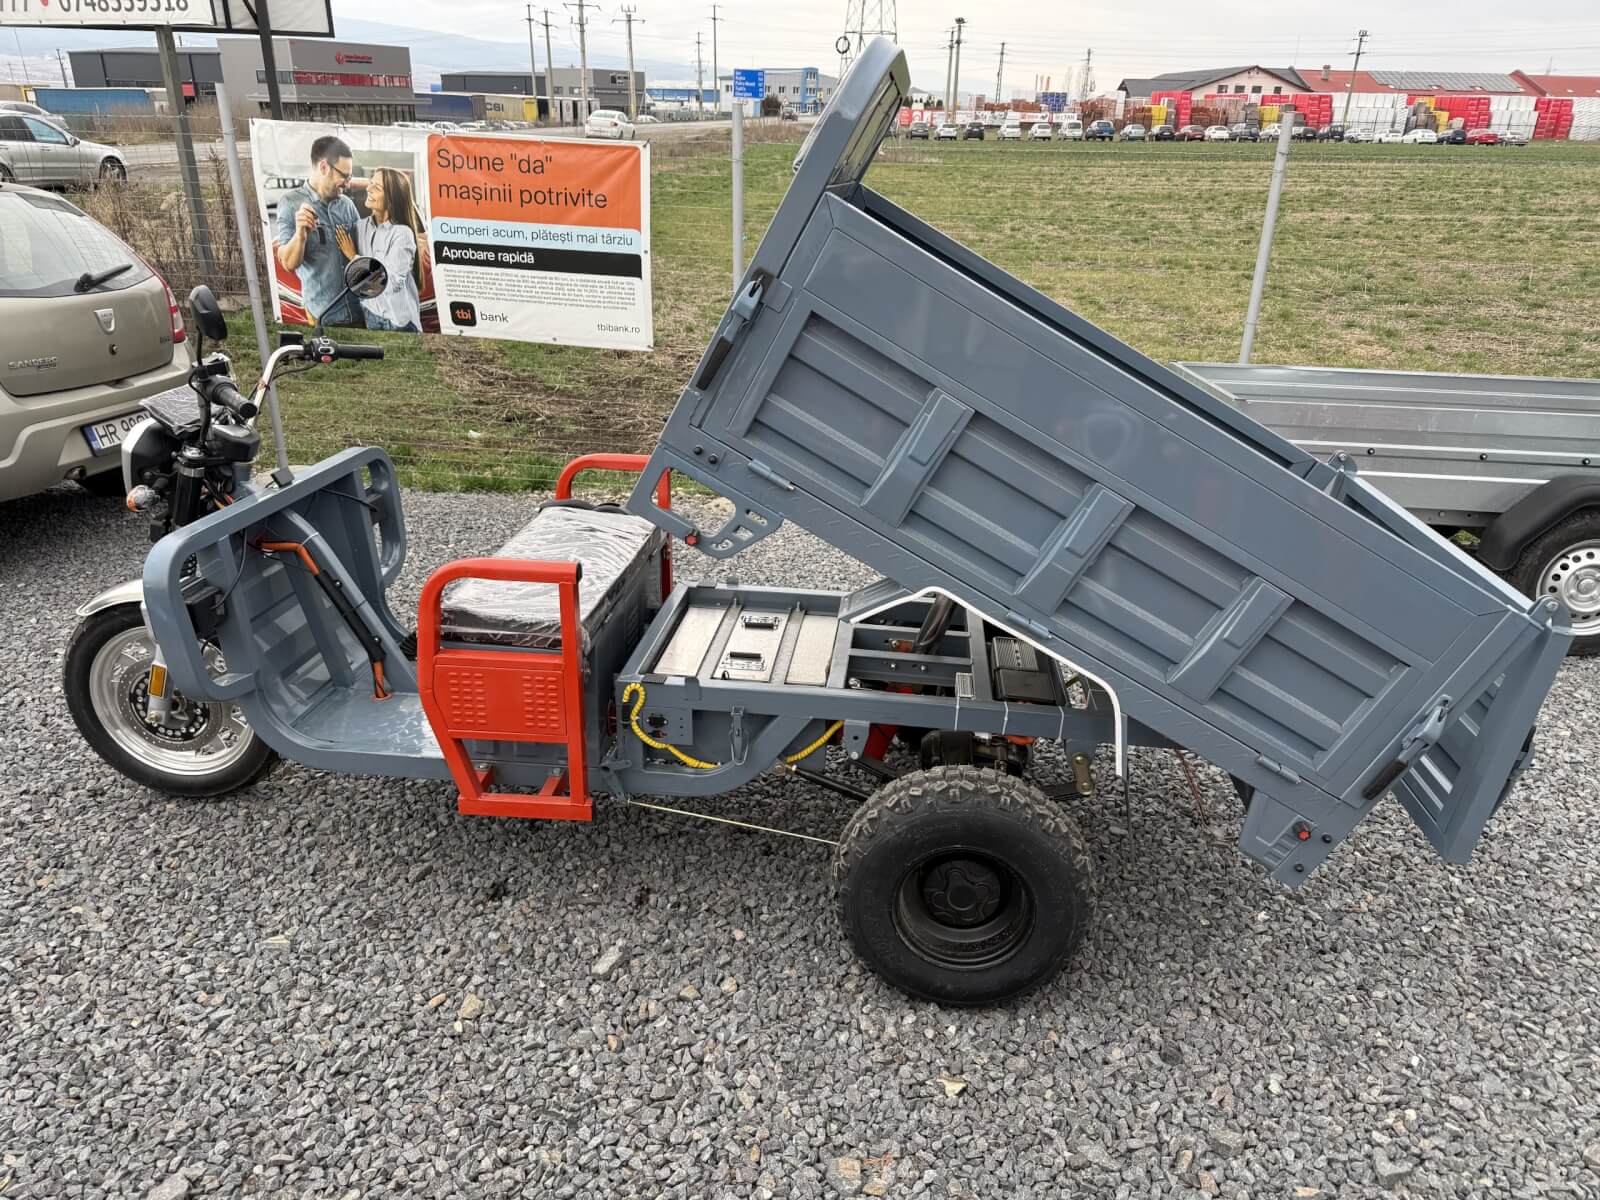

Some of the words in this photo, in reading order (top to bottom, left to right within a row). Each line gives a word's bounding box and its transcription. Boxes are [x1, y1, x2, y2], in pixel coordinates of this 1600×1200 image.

[437, 148, 504, 173] Spune
[510, 153, 553, 174] "da"
[438, 183, 513, 206] mașinii
[520, 187, 608, 209] potrivite
[440, 222, 489, 237] Cumperi
[492, 229, 528, 240] acum,
[531, 230, 574, 244] plătești
[576, 232, 598, 243] mai
[601, 233, 633, 246] târziu
[442, 246, 496, 262] Aprobare
[497, 250, 535, 265] rapidă
[455, 309, 472, 320] tbi
[480, 311, 509, 323] bank
[597, 323, 641, 334] tbibank.ro
